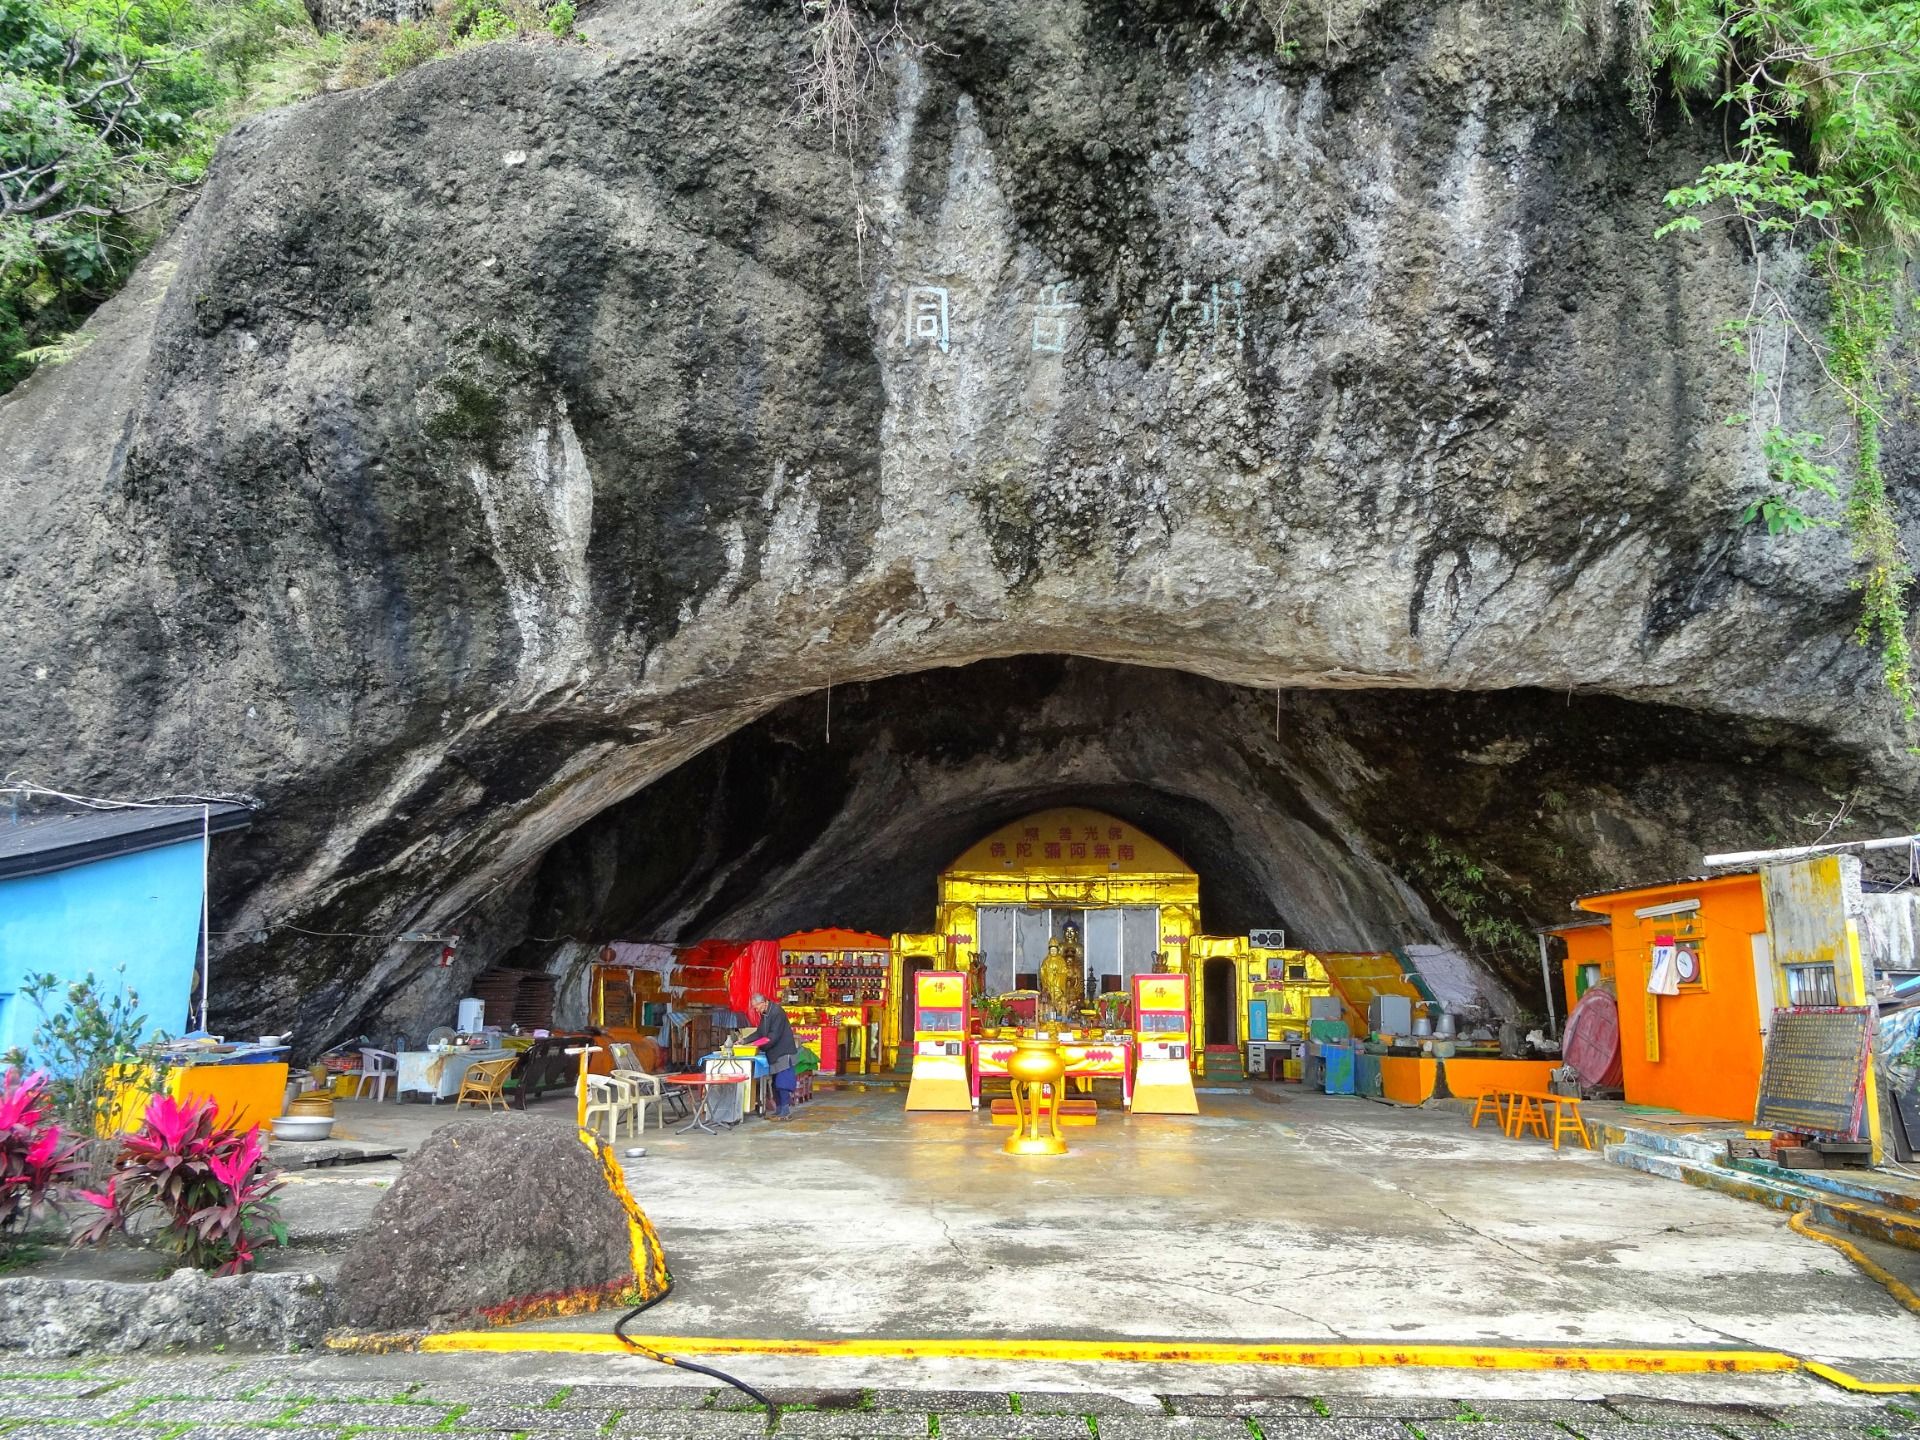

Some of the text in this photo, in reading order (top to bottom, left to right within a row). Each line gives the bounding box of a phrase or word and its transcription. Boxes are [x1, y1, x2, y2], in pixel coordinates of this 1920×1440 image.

[990, 842, 1135, 861] 南無阿彌陀佛
